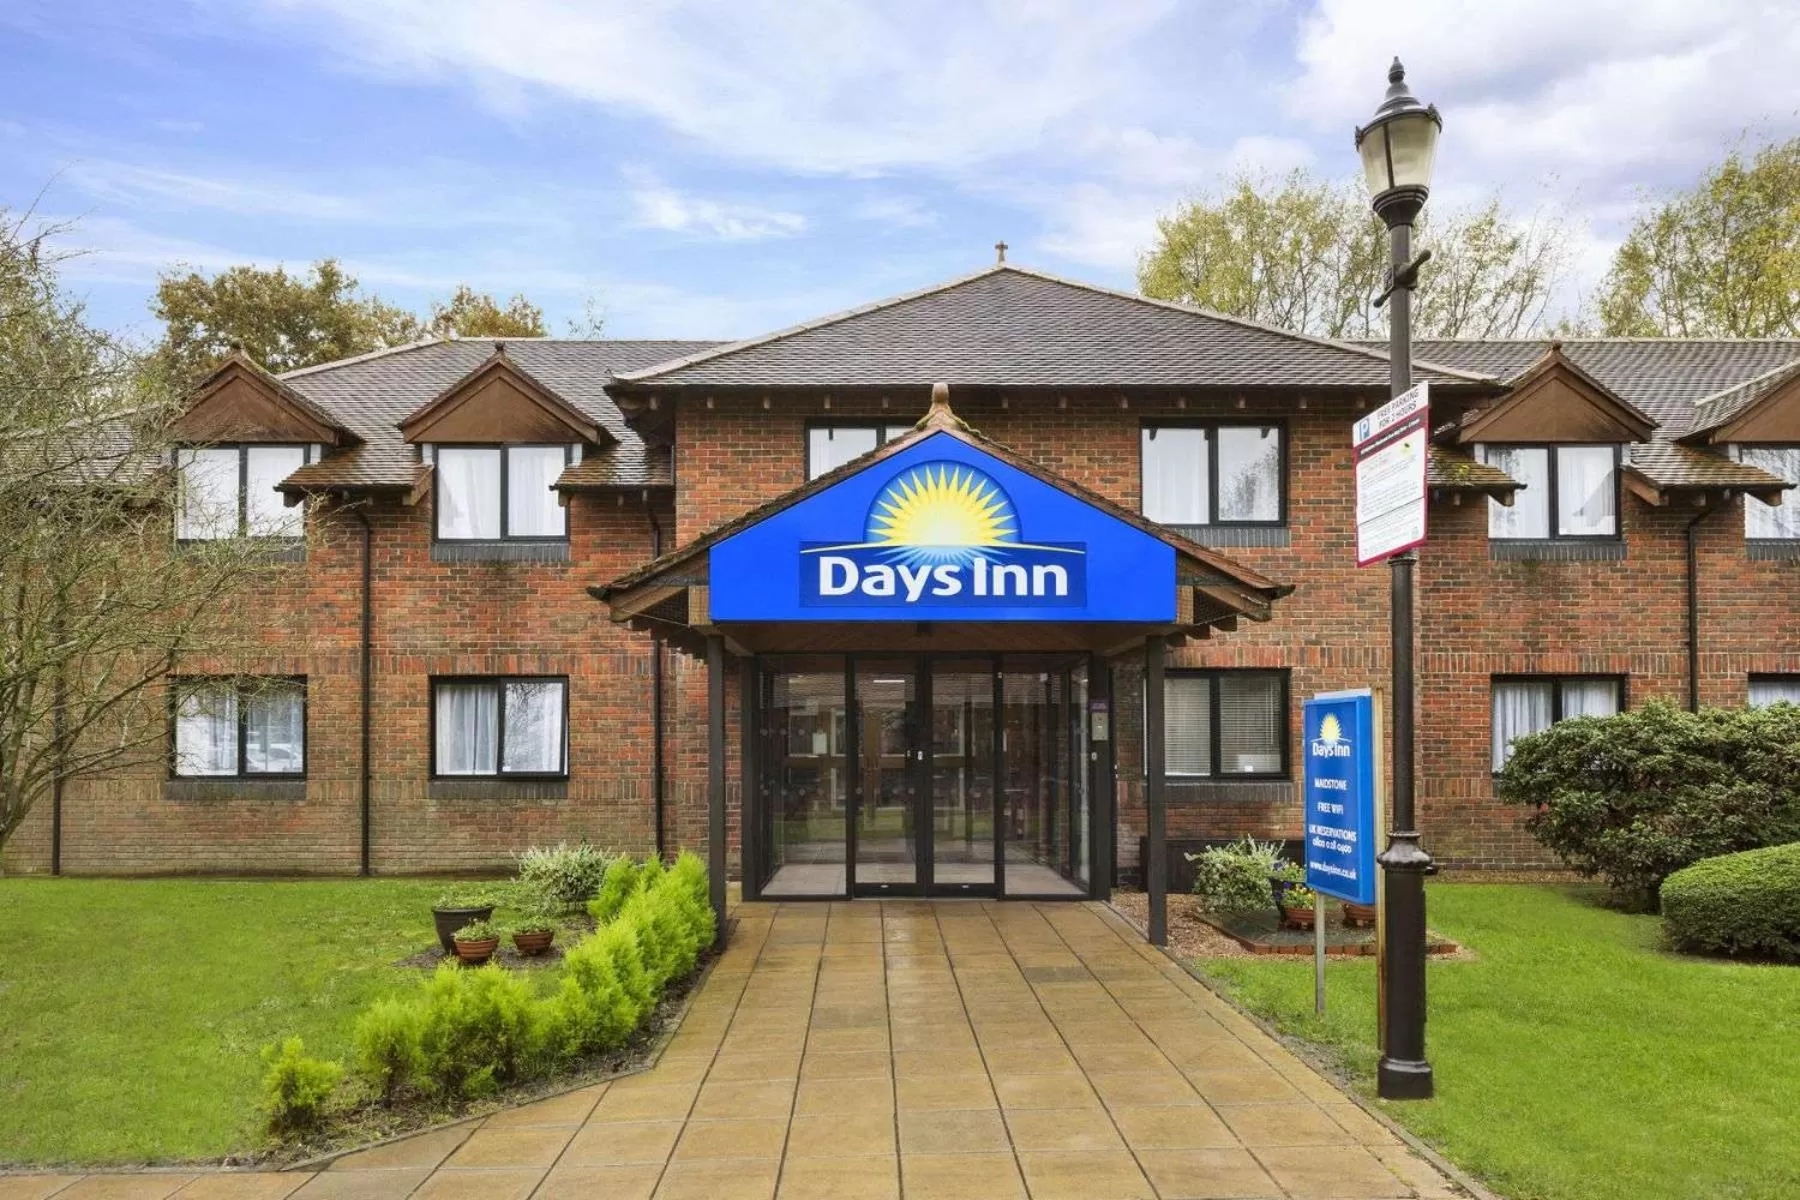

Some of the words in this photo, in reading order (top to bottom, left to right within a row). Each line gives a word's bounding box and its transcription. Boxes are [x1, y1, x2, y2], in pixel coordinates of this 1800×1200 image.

[1392, 388, 1419, 409] PARKING
[1379, 416, 1391, 429] FOR
[1396, 400, 1417, 418] HOURS
[819, 556, 961, 602] Days
[974, 557, 1068, 596] Inn
[1312, 742, 1333, 758] Days
[1334, 743, 1350, 757] Inn
[1314, 778, 1347, 791] MAIDSTONE
[1318, 801, 1331, 813] FREE
[1309, 824, 1317, 835] UK
[1317, 826, 1357, 842] RESERVATIONS
